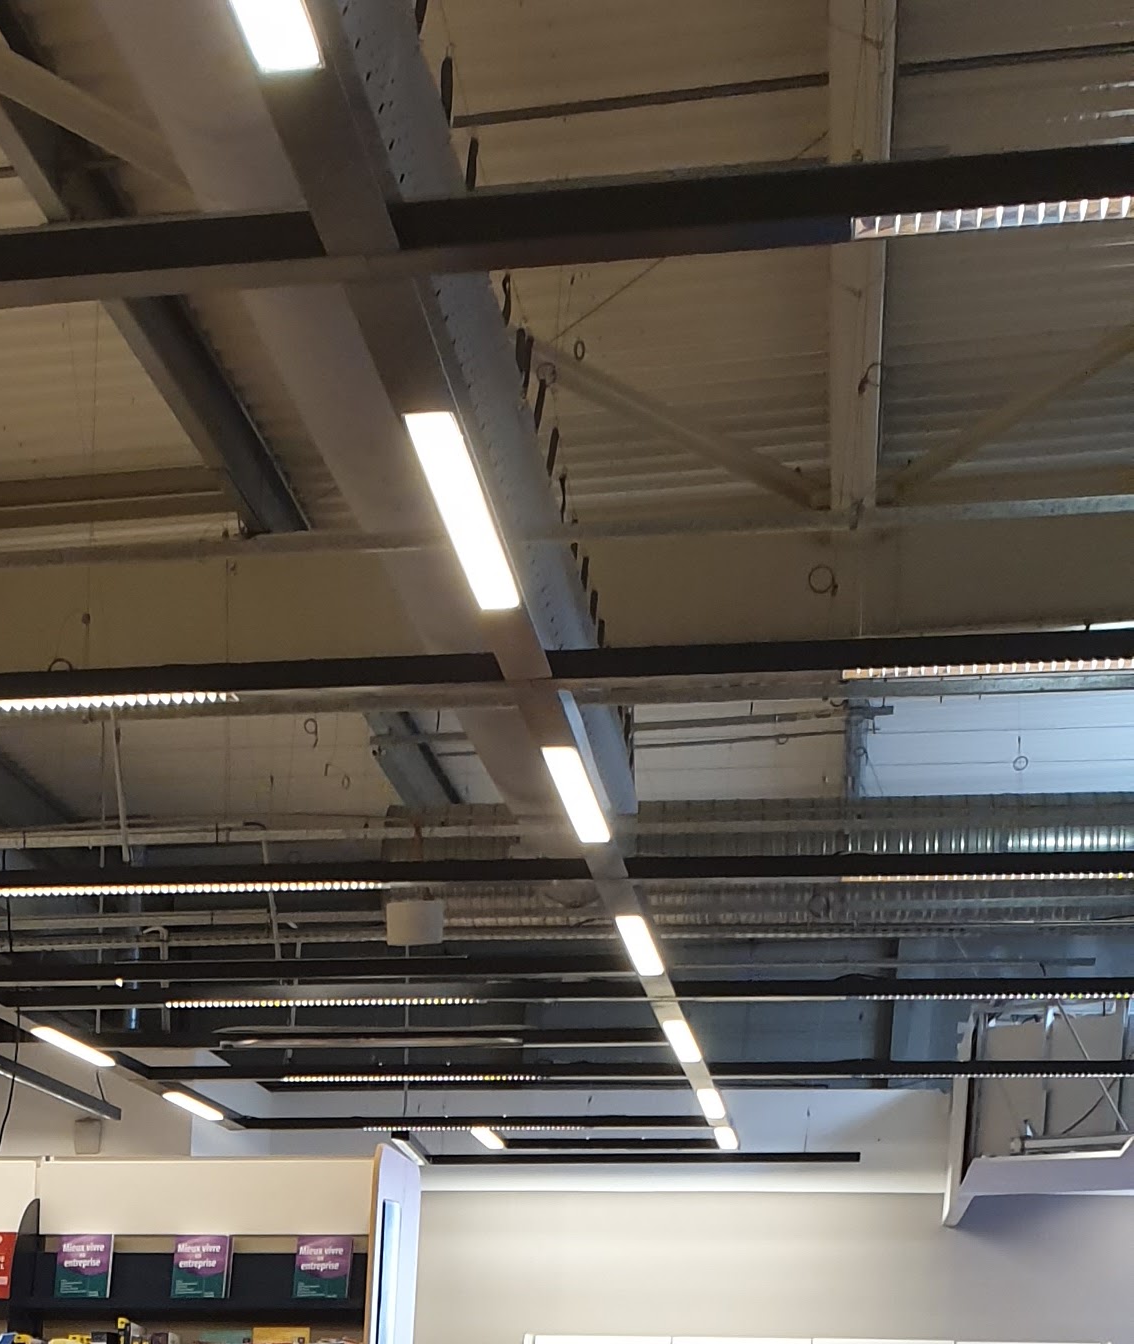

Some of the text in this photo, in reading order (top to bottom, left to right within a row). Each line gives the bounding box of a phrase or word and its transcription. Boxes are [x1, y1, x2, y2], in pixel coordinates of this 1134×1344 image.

[63, 1243, 105, 1253] Mieux vivre
[177, 1243, 220, 1253] Mieux vivre
[299, 1246, 343, 1256] Mieux vivre
[64, 1257, 101, 1269] entreprise
[179, 1258, 217, 1270] entreprise
[301, 1261, 340, 1272] entreprise
